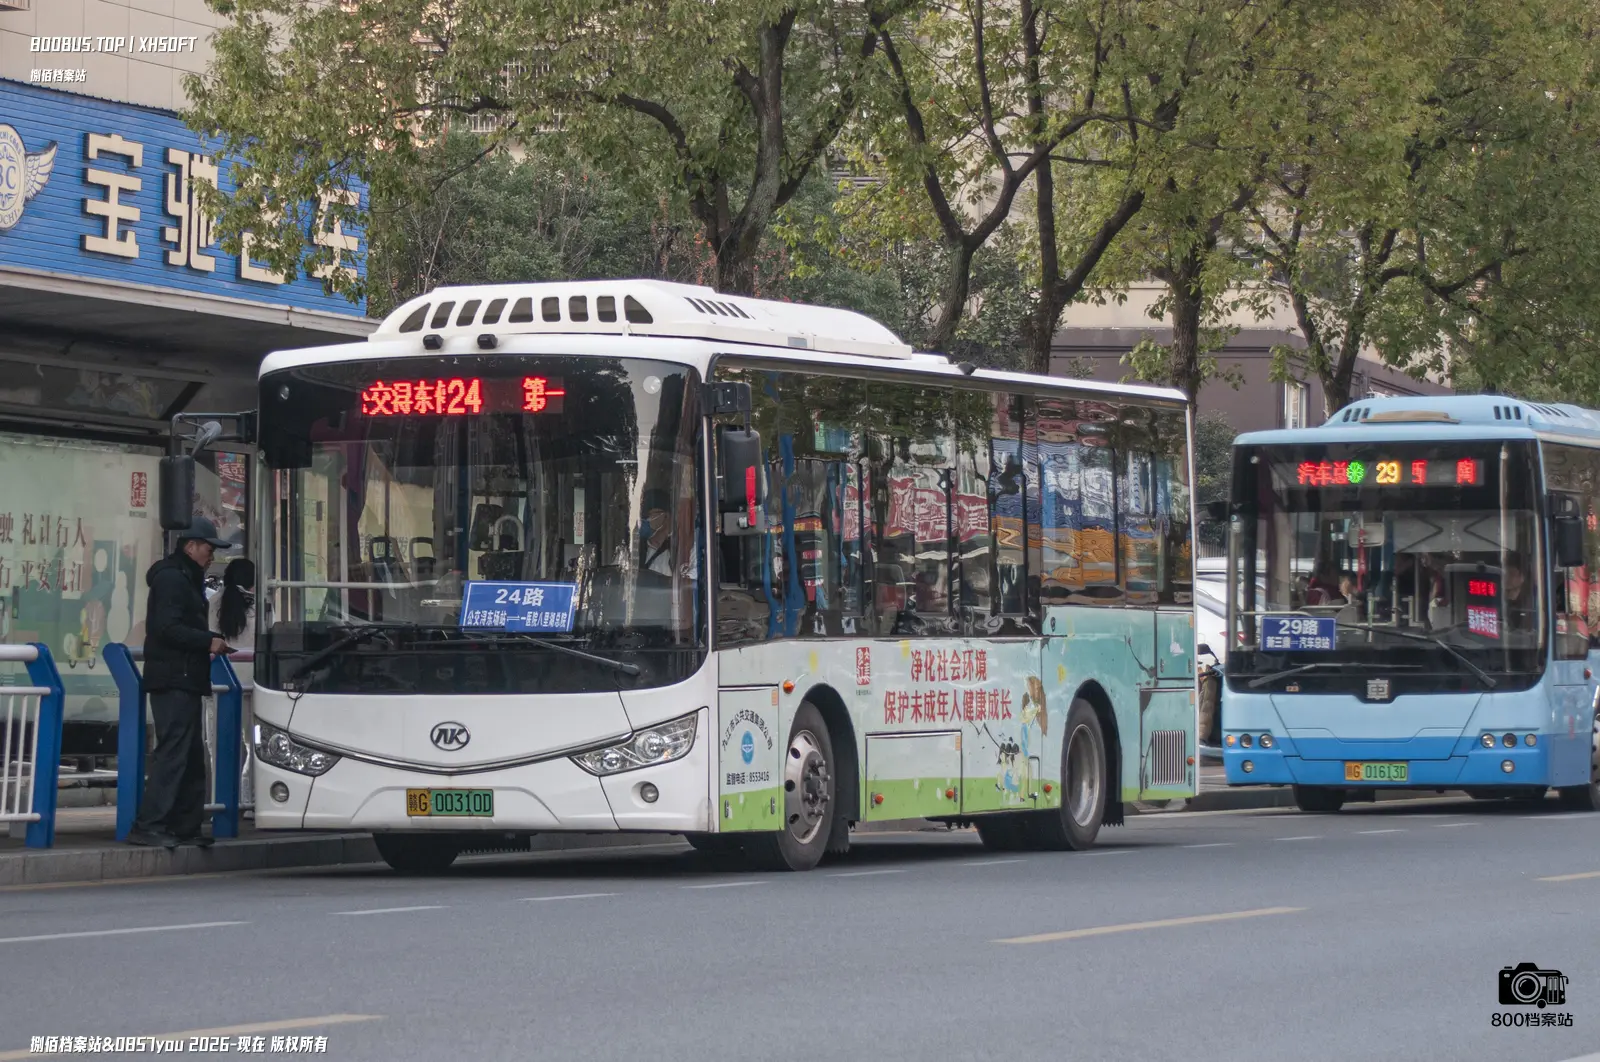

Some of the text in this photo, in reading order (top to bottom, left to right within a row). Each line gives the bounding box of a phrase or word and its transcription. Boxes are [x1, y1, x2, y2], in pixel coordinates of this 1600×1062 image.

[447, 379, 482, 414] 24
[523, 377, 565, 412] 第一
[1375, 462, 1400, 484] 29
[23, 512, 87, 548] 礼让行人
[21, 559, 84, 592] 平安九江
[495, 588, 544, 606] 24路
[1278, 620, 1318, 635] 29路
[911, 649, 988, 682] 净化社会环境
[884, 688, 1012, 724] 保护未成年人健康成长
